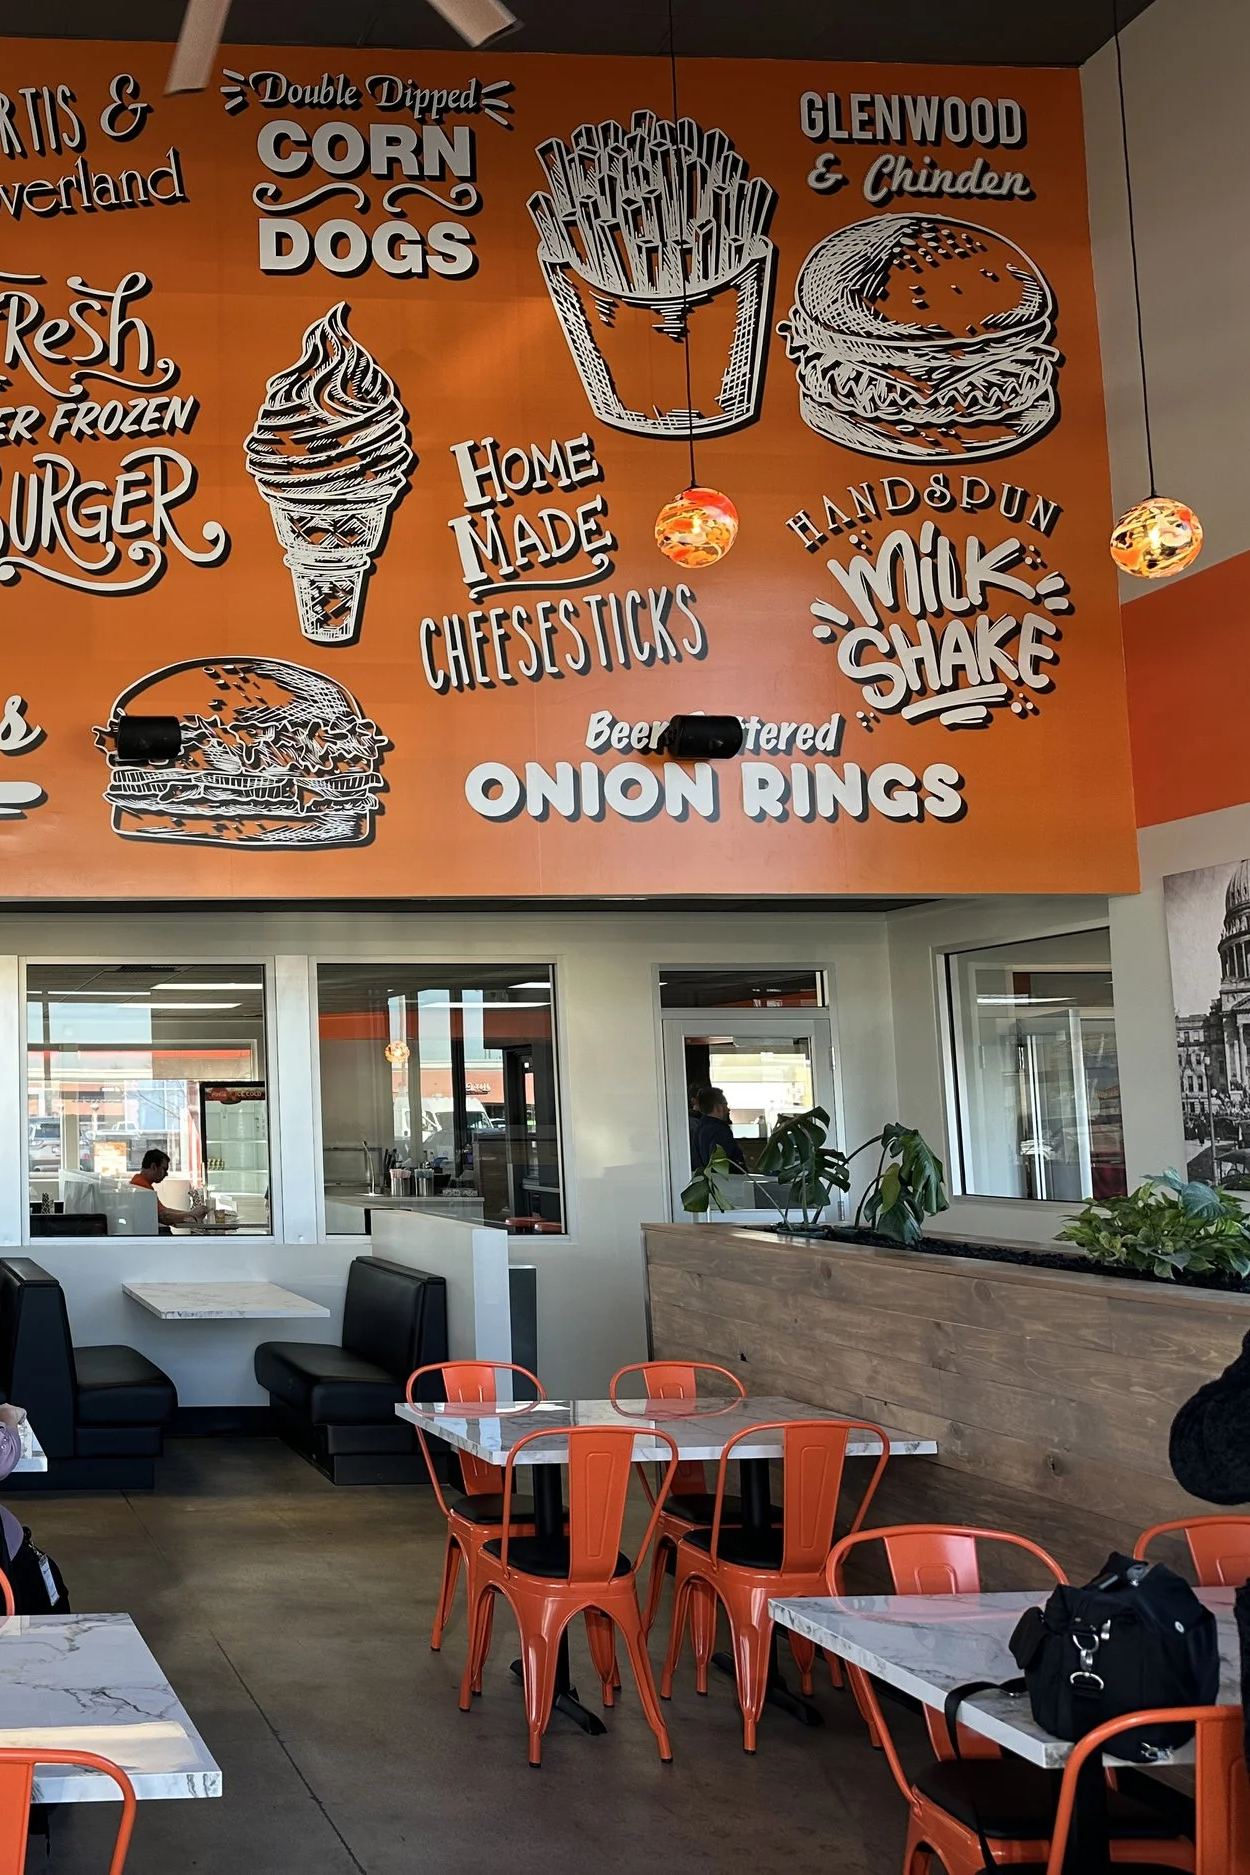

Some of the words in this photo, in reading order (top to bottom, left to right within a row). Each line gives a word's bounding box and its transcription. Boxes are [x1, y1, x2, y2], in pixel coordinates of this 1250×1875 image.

[100, 73, 149, 138] &
[249, 70, 357, 107] Double
[366, 74, 478, 119] Dipped
[800, 91, 1022, 145] GLENWOOD
[257, 119, 471, 177] CORN
[806, 152, 843, 190] &
[863, 153, 1031, 202] Chinden
[258, 218, 473, 275] DOGS
[48, 395, 195, 439] FROZEN
[450, 432, 599, 507] HOME
[447, 494, 612, 583] MADE
[784, 473, 1059, 549] HANDSPUN
[419, 583, 702, 690] CHEESESTICKS
[838, 612, 1056, 709] SHAKE
[585, 710, 670, 750] Beer
[465, 761, 714, 818] ONION
[741, 762, 963, 819] RINGS
